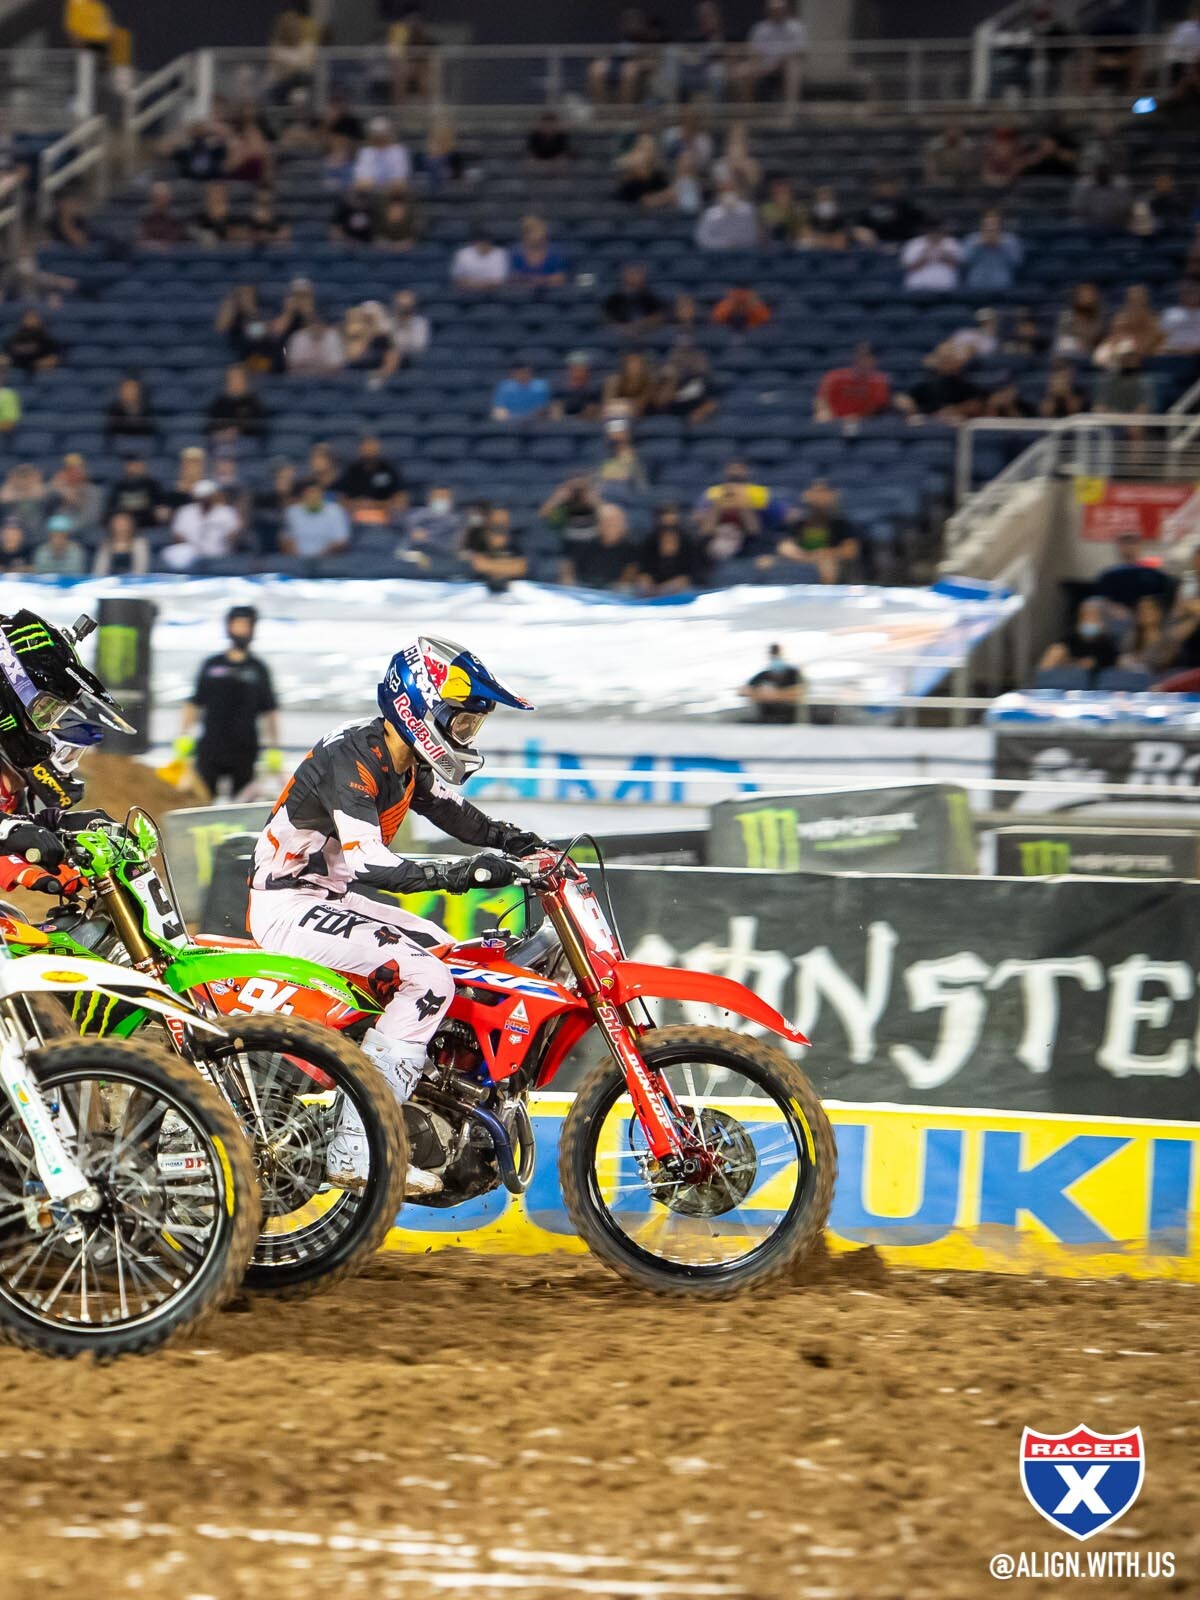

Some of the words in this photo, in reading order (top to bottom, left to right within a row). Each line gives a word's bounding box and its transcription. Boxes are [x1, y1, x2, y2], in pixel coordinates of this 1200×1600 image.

[298, 904, 371, 939] FOX
[504, 1019, 531, 1036] HRC
[628, 915, 1200, 1090] ONSTE
[628, 1052, 671, 1129] DUNLOP
